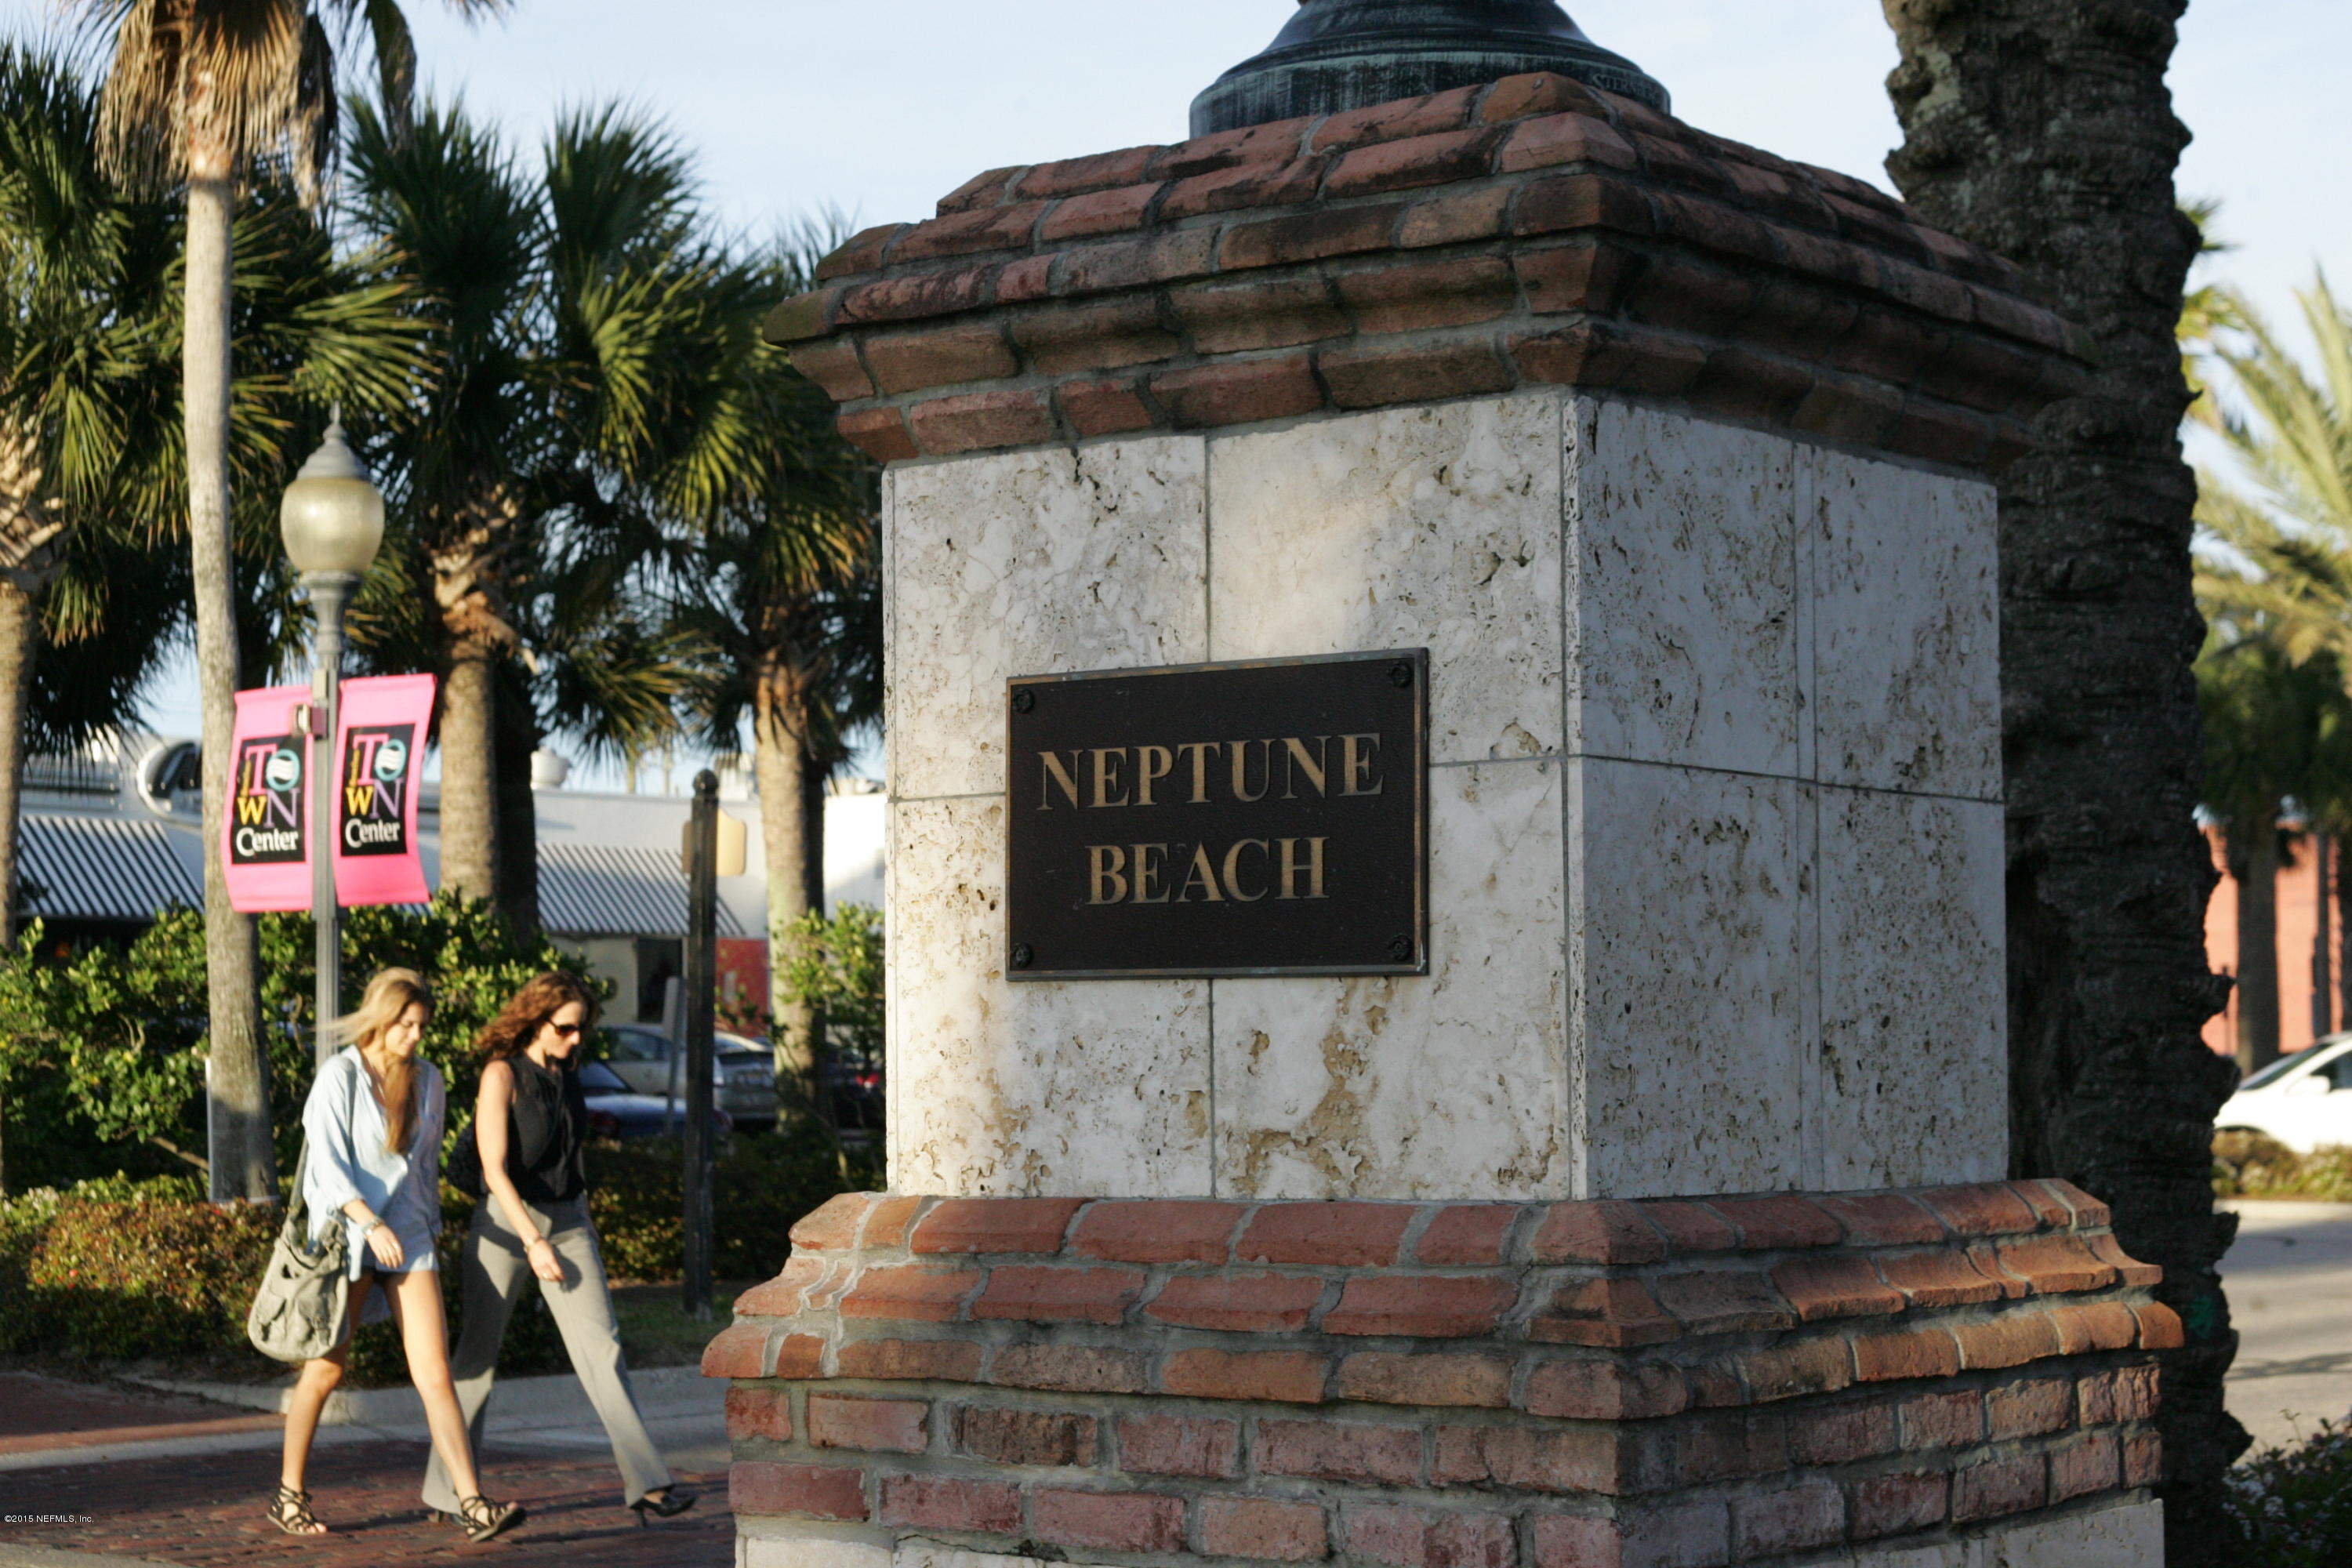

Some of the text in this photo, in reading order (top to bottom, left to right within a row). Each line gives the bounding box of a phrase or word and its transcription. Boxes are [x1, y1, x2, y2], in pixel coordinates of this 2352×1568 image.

[1036, 732, 1384, 811] NEPTUNE
[236, 827, 299, 857] Center
[345, 818, 401, 848] Center
[1085, 836, 1330, 906] BEACH
